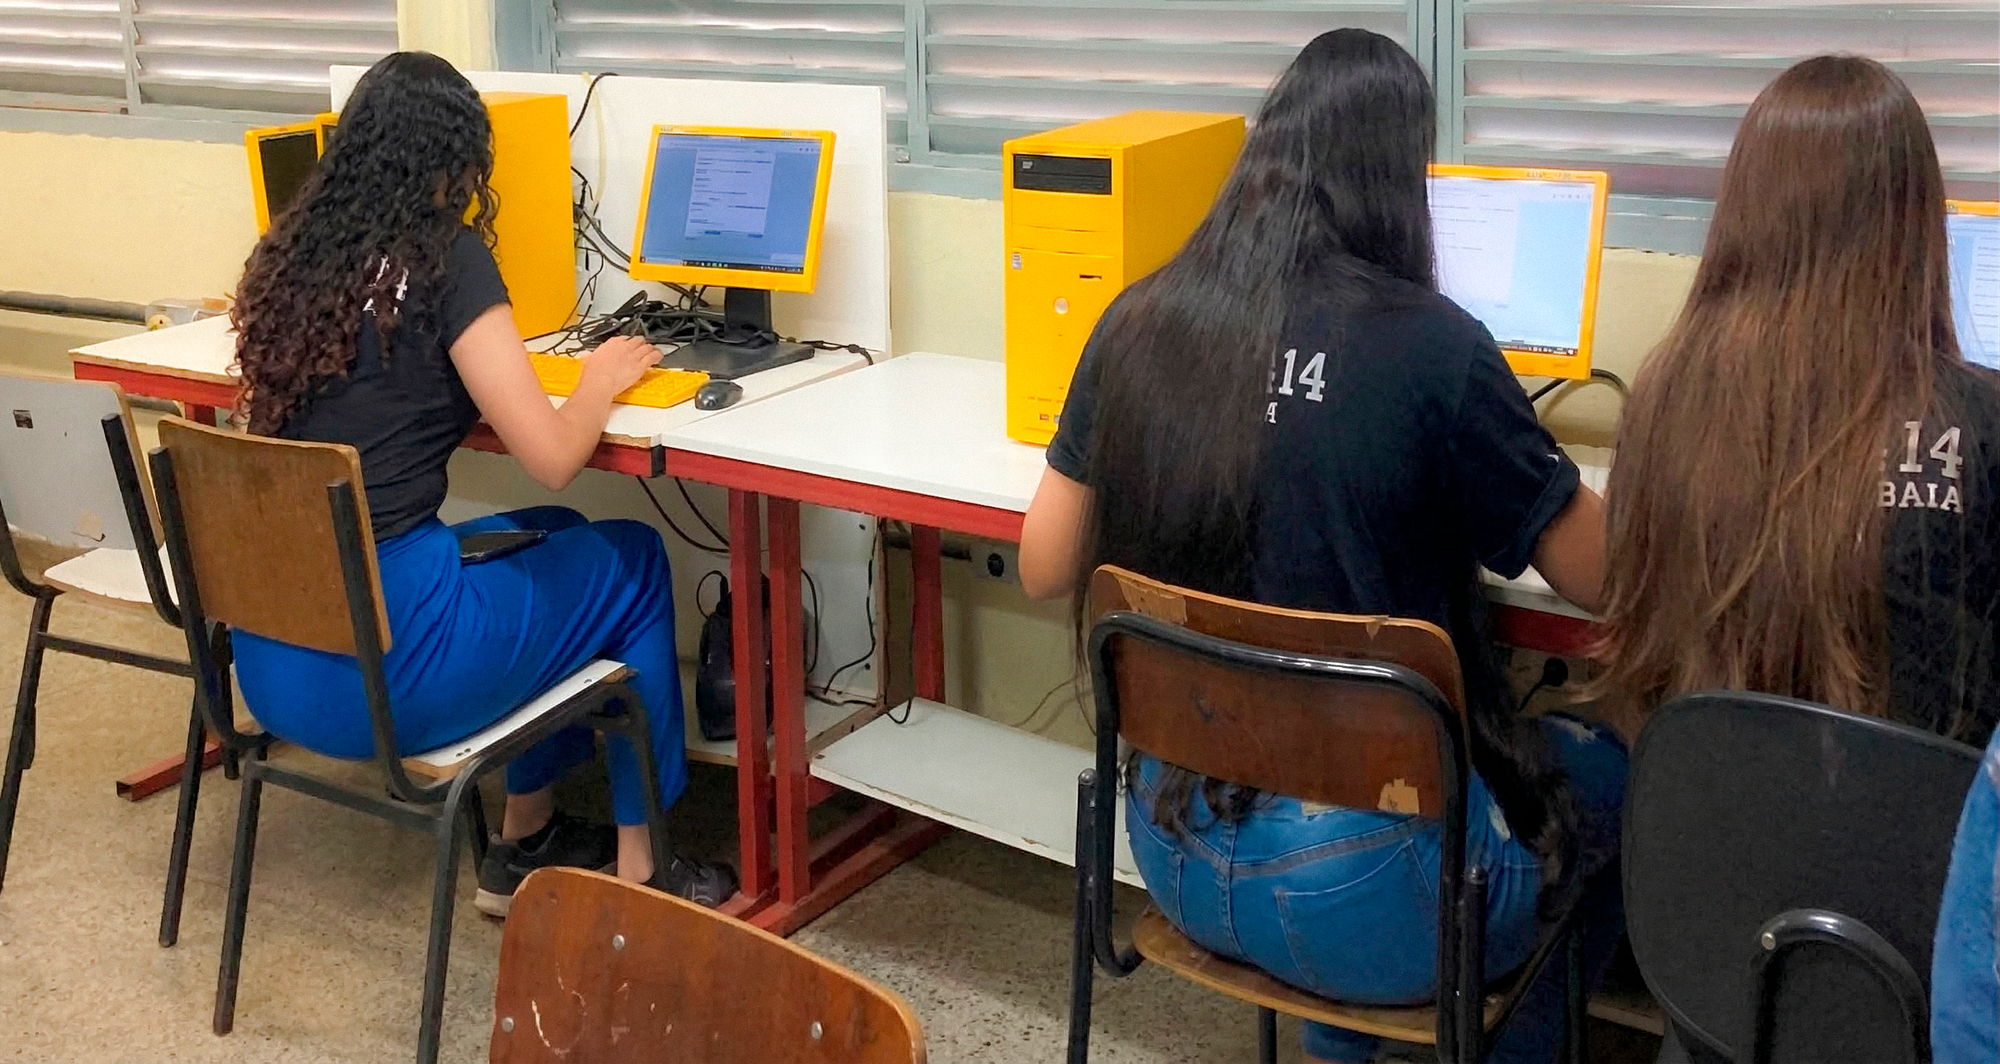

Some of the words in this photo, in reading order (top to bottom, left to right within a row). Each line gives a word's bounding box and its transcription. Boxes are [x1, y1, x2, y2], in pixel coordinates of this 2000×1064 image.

[1266, 345, 1326, 402] 14
[1879, 421, 1963, 480] 14
[1878, 481, 1964, 514] BAIA
